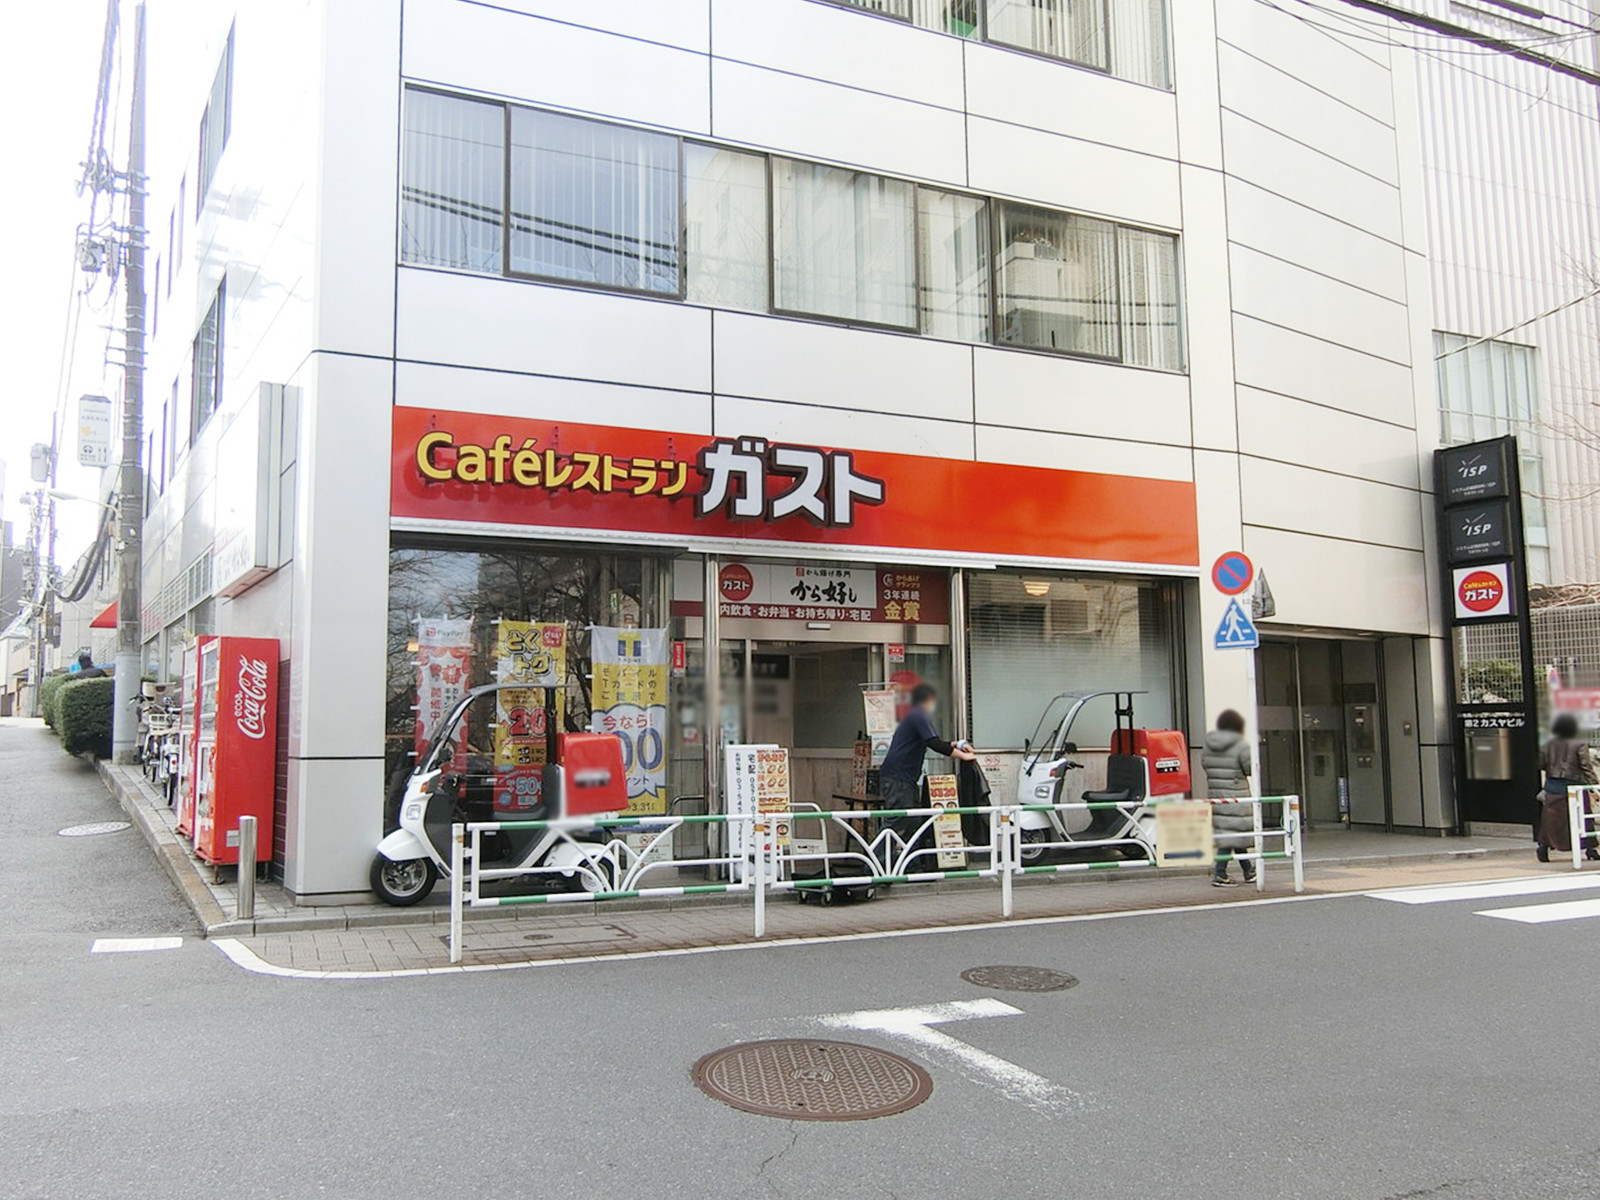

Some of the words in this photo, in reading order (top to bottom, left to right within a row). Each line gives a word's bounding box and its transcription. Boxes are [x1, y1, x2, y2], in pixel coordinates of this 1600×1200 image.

[416, 431, 687, 496] Caféレストラン
[702, 440, 883, 524] ガスト
[1462, 464, 1488, 478] ISP
[1466, 523, 1492, 536] ISP
[723, 580, 750, 591] ガスト
[1464, 589, 1500, 601] ガスト
[884, 601, 921, 621] 金賞
